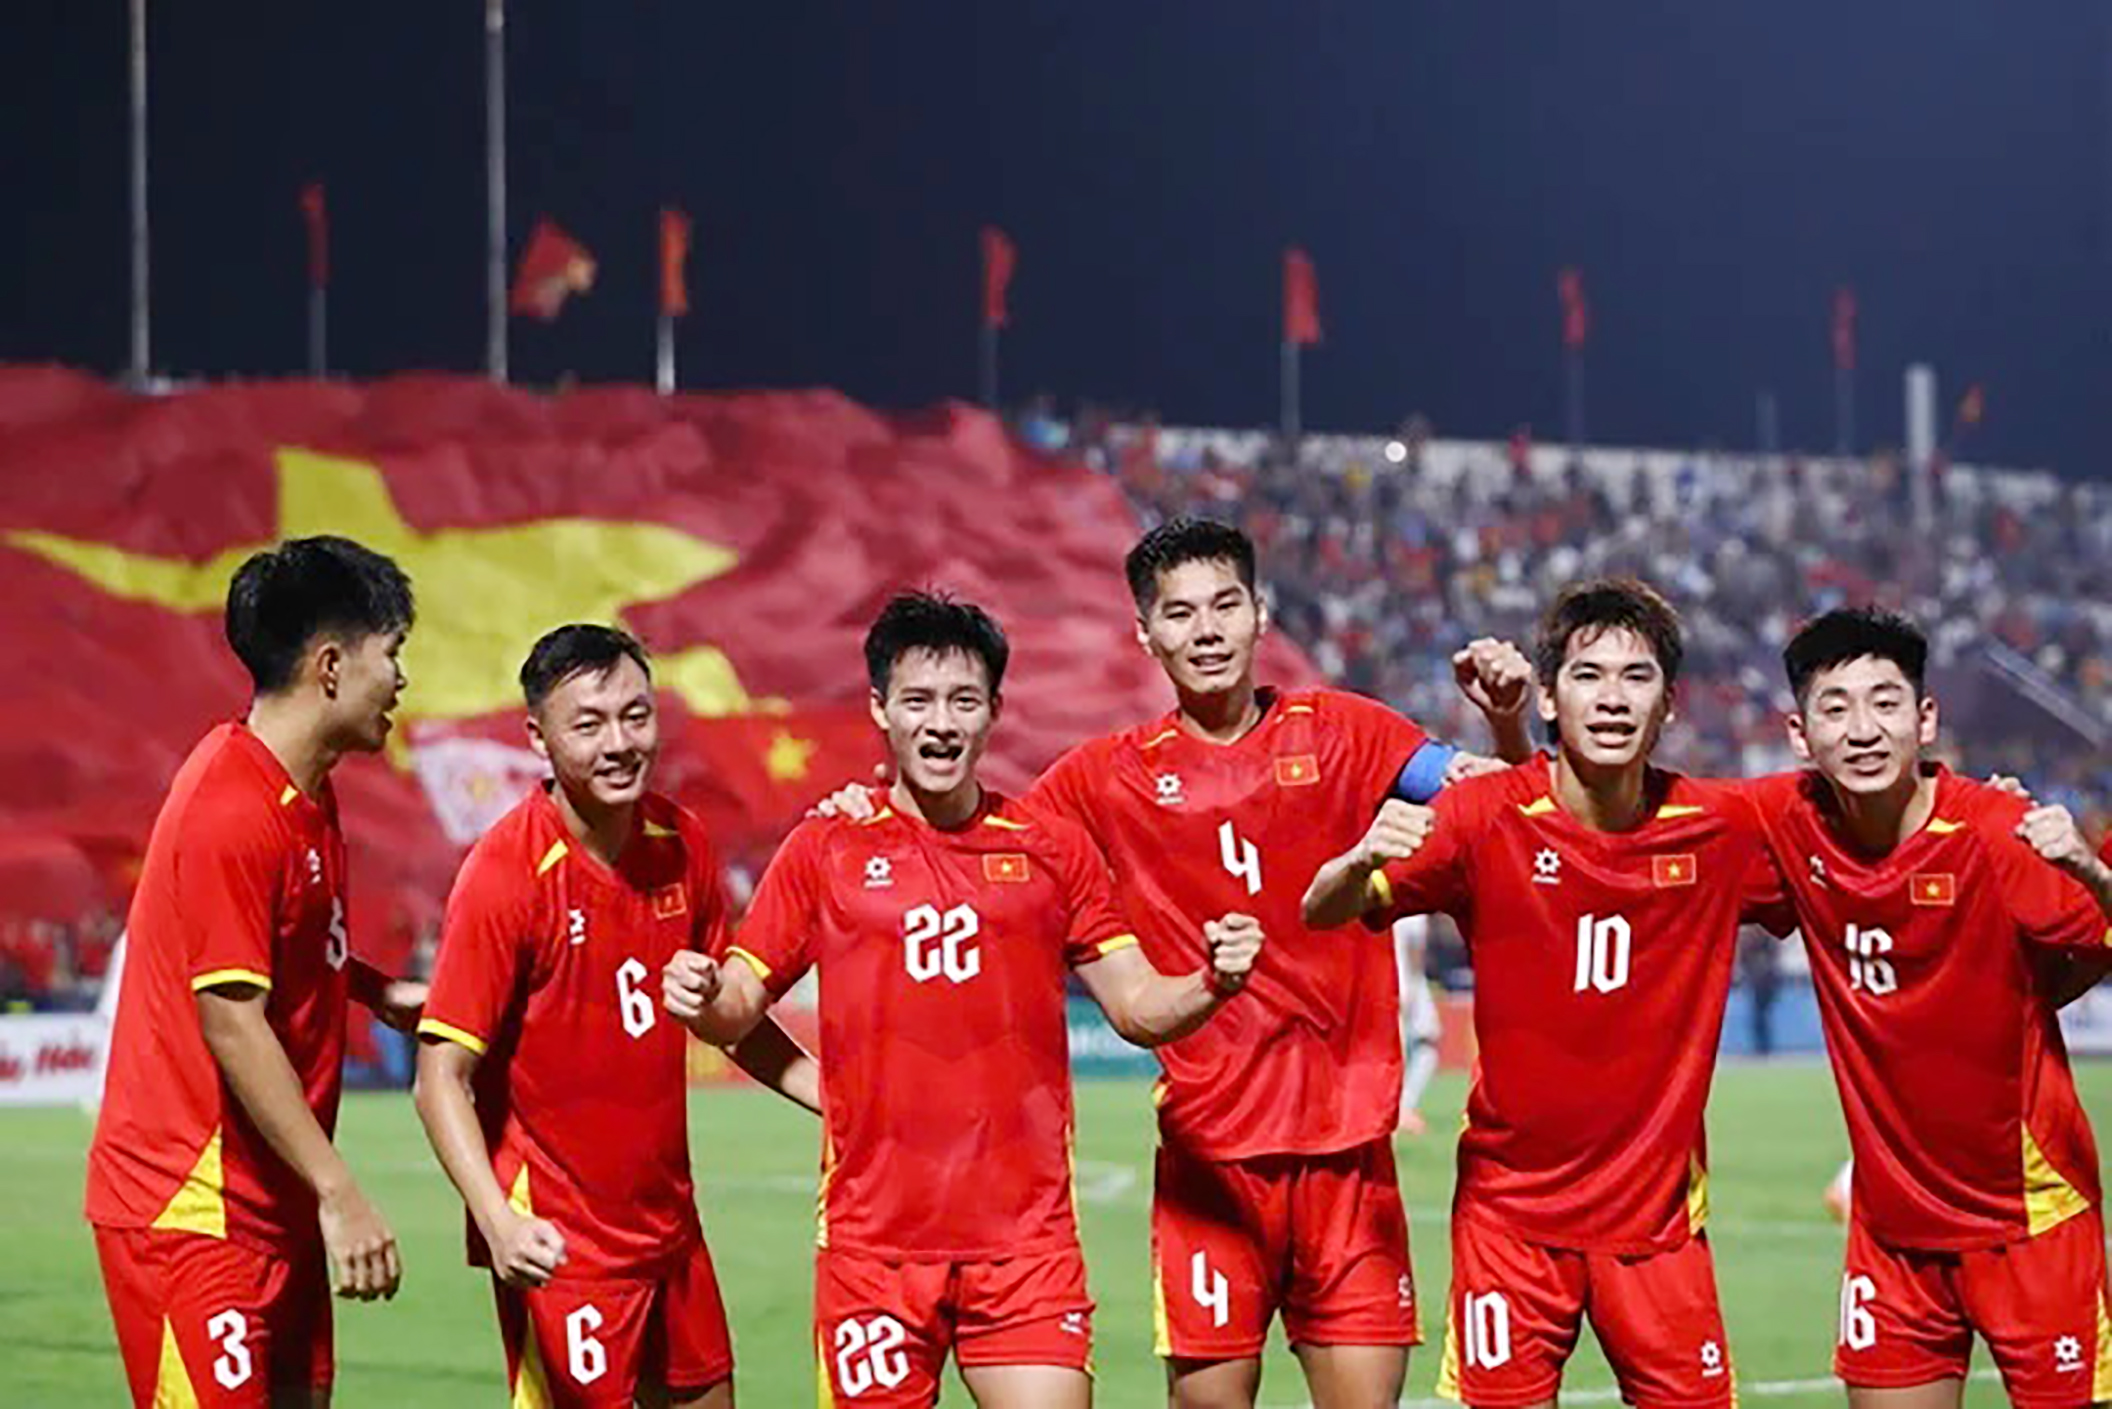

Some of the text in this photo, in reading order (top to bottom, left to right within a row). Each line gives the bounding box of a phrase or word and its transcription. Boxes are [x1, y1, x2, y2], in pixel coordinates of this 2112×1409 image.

[1219, 821, 1261, 895] 4
[905, 903, 980, 983] 22
[1574, 914, 1630, 993] 10
[1845, 923, 1898, 995] 16
[617, 958, 655, 1038] 6
[1192, 1251, 1228, 1327] 4
[1840, 1273, 1876, 1351] 16
[208, 1309, 251, 1389] 3
[566, 1304, 606, 1384] 6
[835, 1315, 910, 1397] 22
[1465, 1291, 1511, 1369] 10
